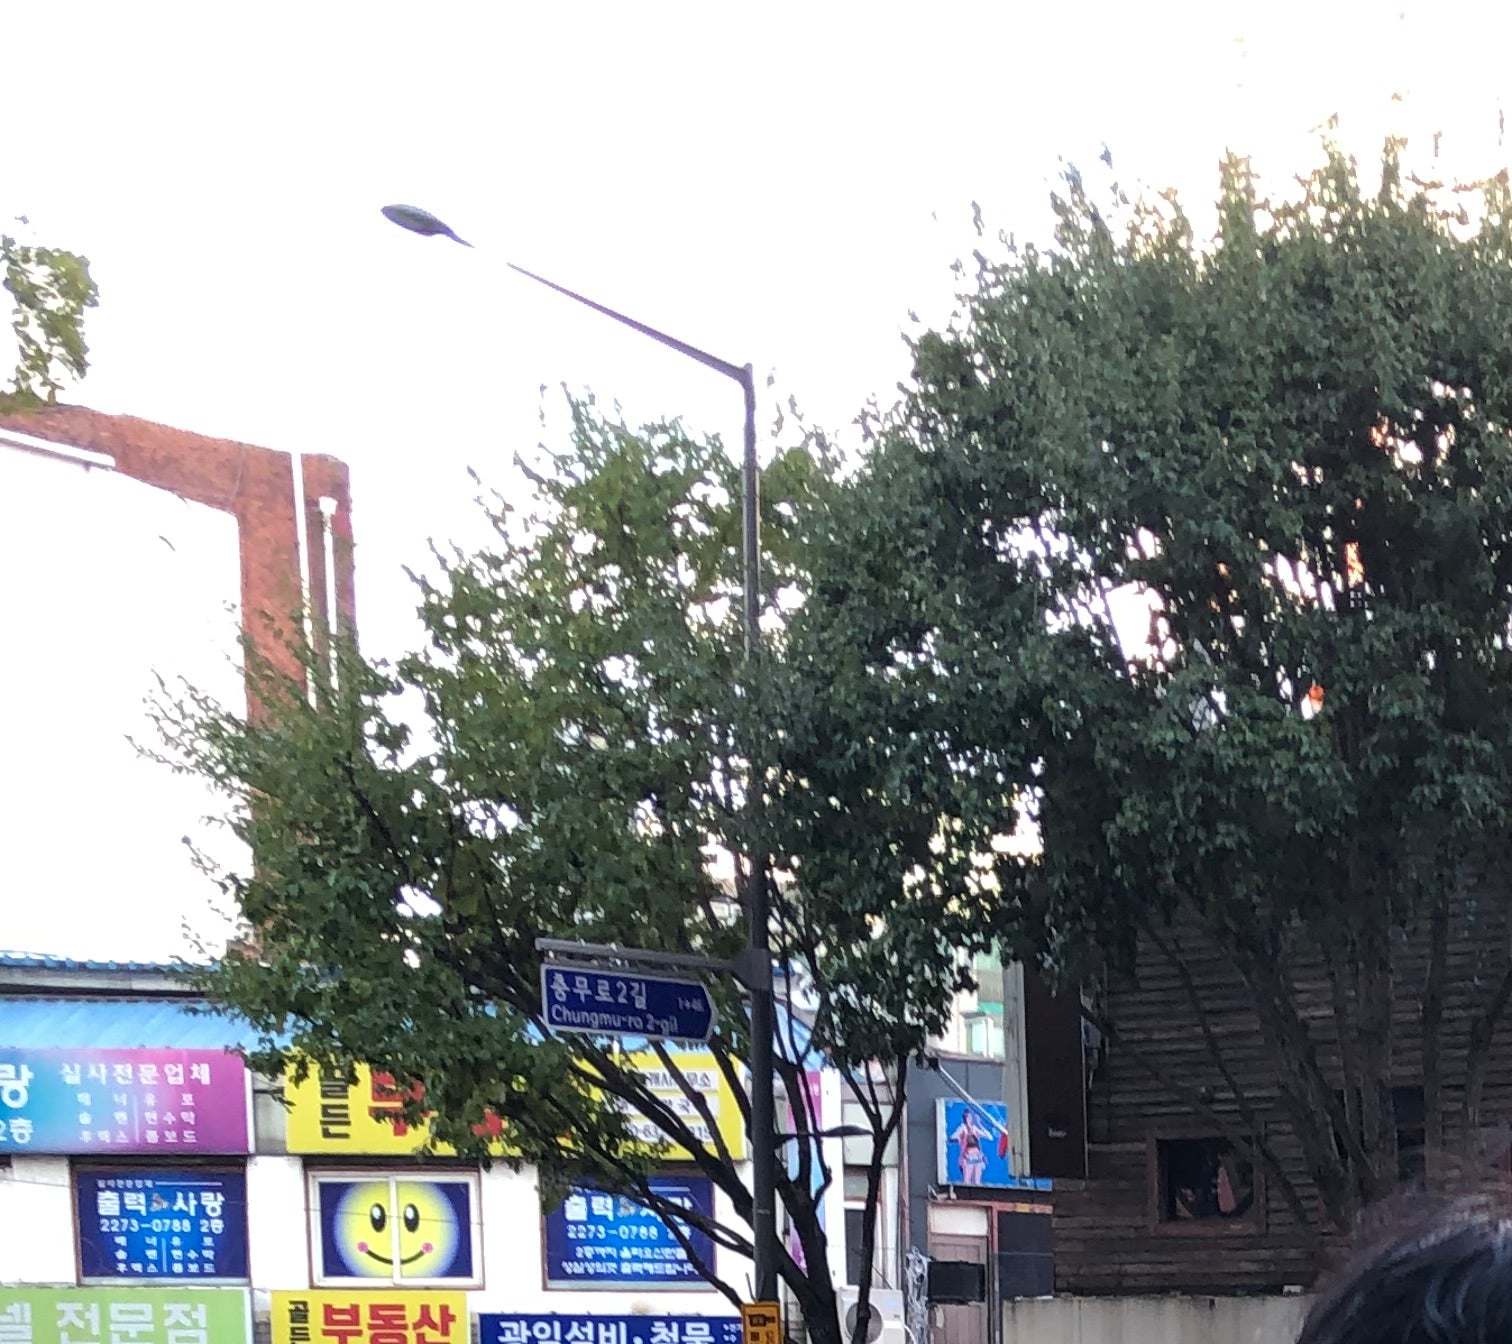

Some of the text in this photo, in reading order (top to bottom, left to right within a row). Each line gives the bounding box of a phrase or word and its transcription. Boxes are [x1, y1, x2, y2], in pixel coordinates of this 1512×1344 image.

[551, 973, 647, 1010] 충무로2길
[551, 1006, 643, 1029] Chungmu-ro
[61, 1063, 211, 1085] 실사전문업체
[97, 1191, 225, 1217] 출력 사랑
